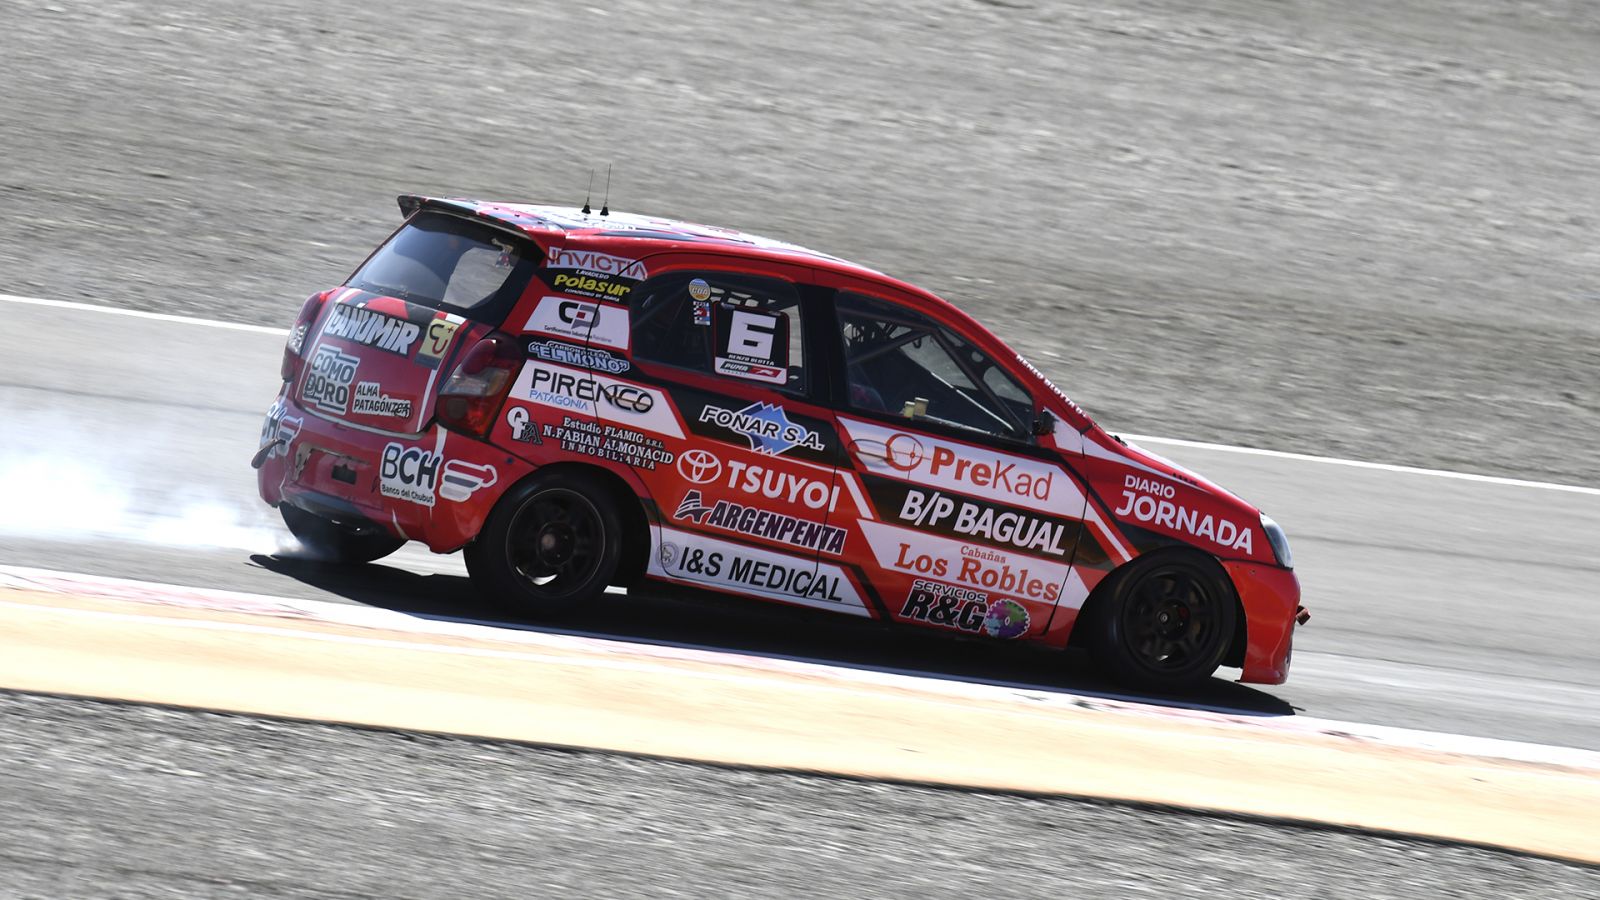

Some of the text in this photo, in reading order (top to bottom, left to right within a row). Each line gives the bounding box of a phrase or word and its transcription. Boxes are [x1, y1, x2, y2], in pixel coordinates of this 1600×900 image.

[554, 274, 631, 296] Polasur
[727, 310, 776, 360] 6
[312, 353, 355, 383] COMO
[356, 385, 378, 397] ALMA
[530, 389, 588, 410] PATAGONIA
[531, 368, 654, 414] PIRENCO
[564, 416, 601, 434] Estudio
[604, 427, 644, 444] FLAMIG
[700, 406, 825, 450] FONAR S.A.
[382, 445, 441, 489] BCH
[561, 440, 656, 470] INMOBILIARIA
[604, 438, 674, 465] ALMONACID
[930, 445, 1053, 502] PreKad
[381, 484, 434, 504] Banco del Chubut
[728, 460, 840, 513] TSUYOI
[1124, 474, 1176, 499] DIARIO
[707, 500, 847, 555] ARGENPENTA
[899, 490, 1065, 556] B/P BAGUAL
[1115, 490, 1253, 555] JORNADA
[678, 547, 842, 602] I&S MEDICAL
[895, 543, 1060, 602] Los Robles
[960, 545, 1007, 564] Cabañas
[900, 588, 988, 633] R&G
[914, 580, 987, 603] SERVICIOS
